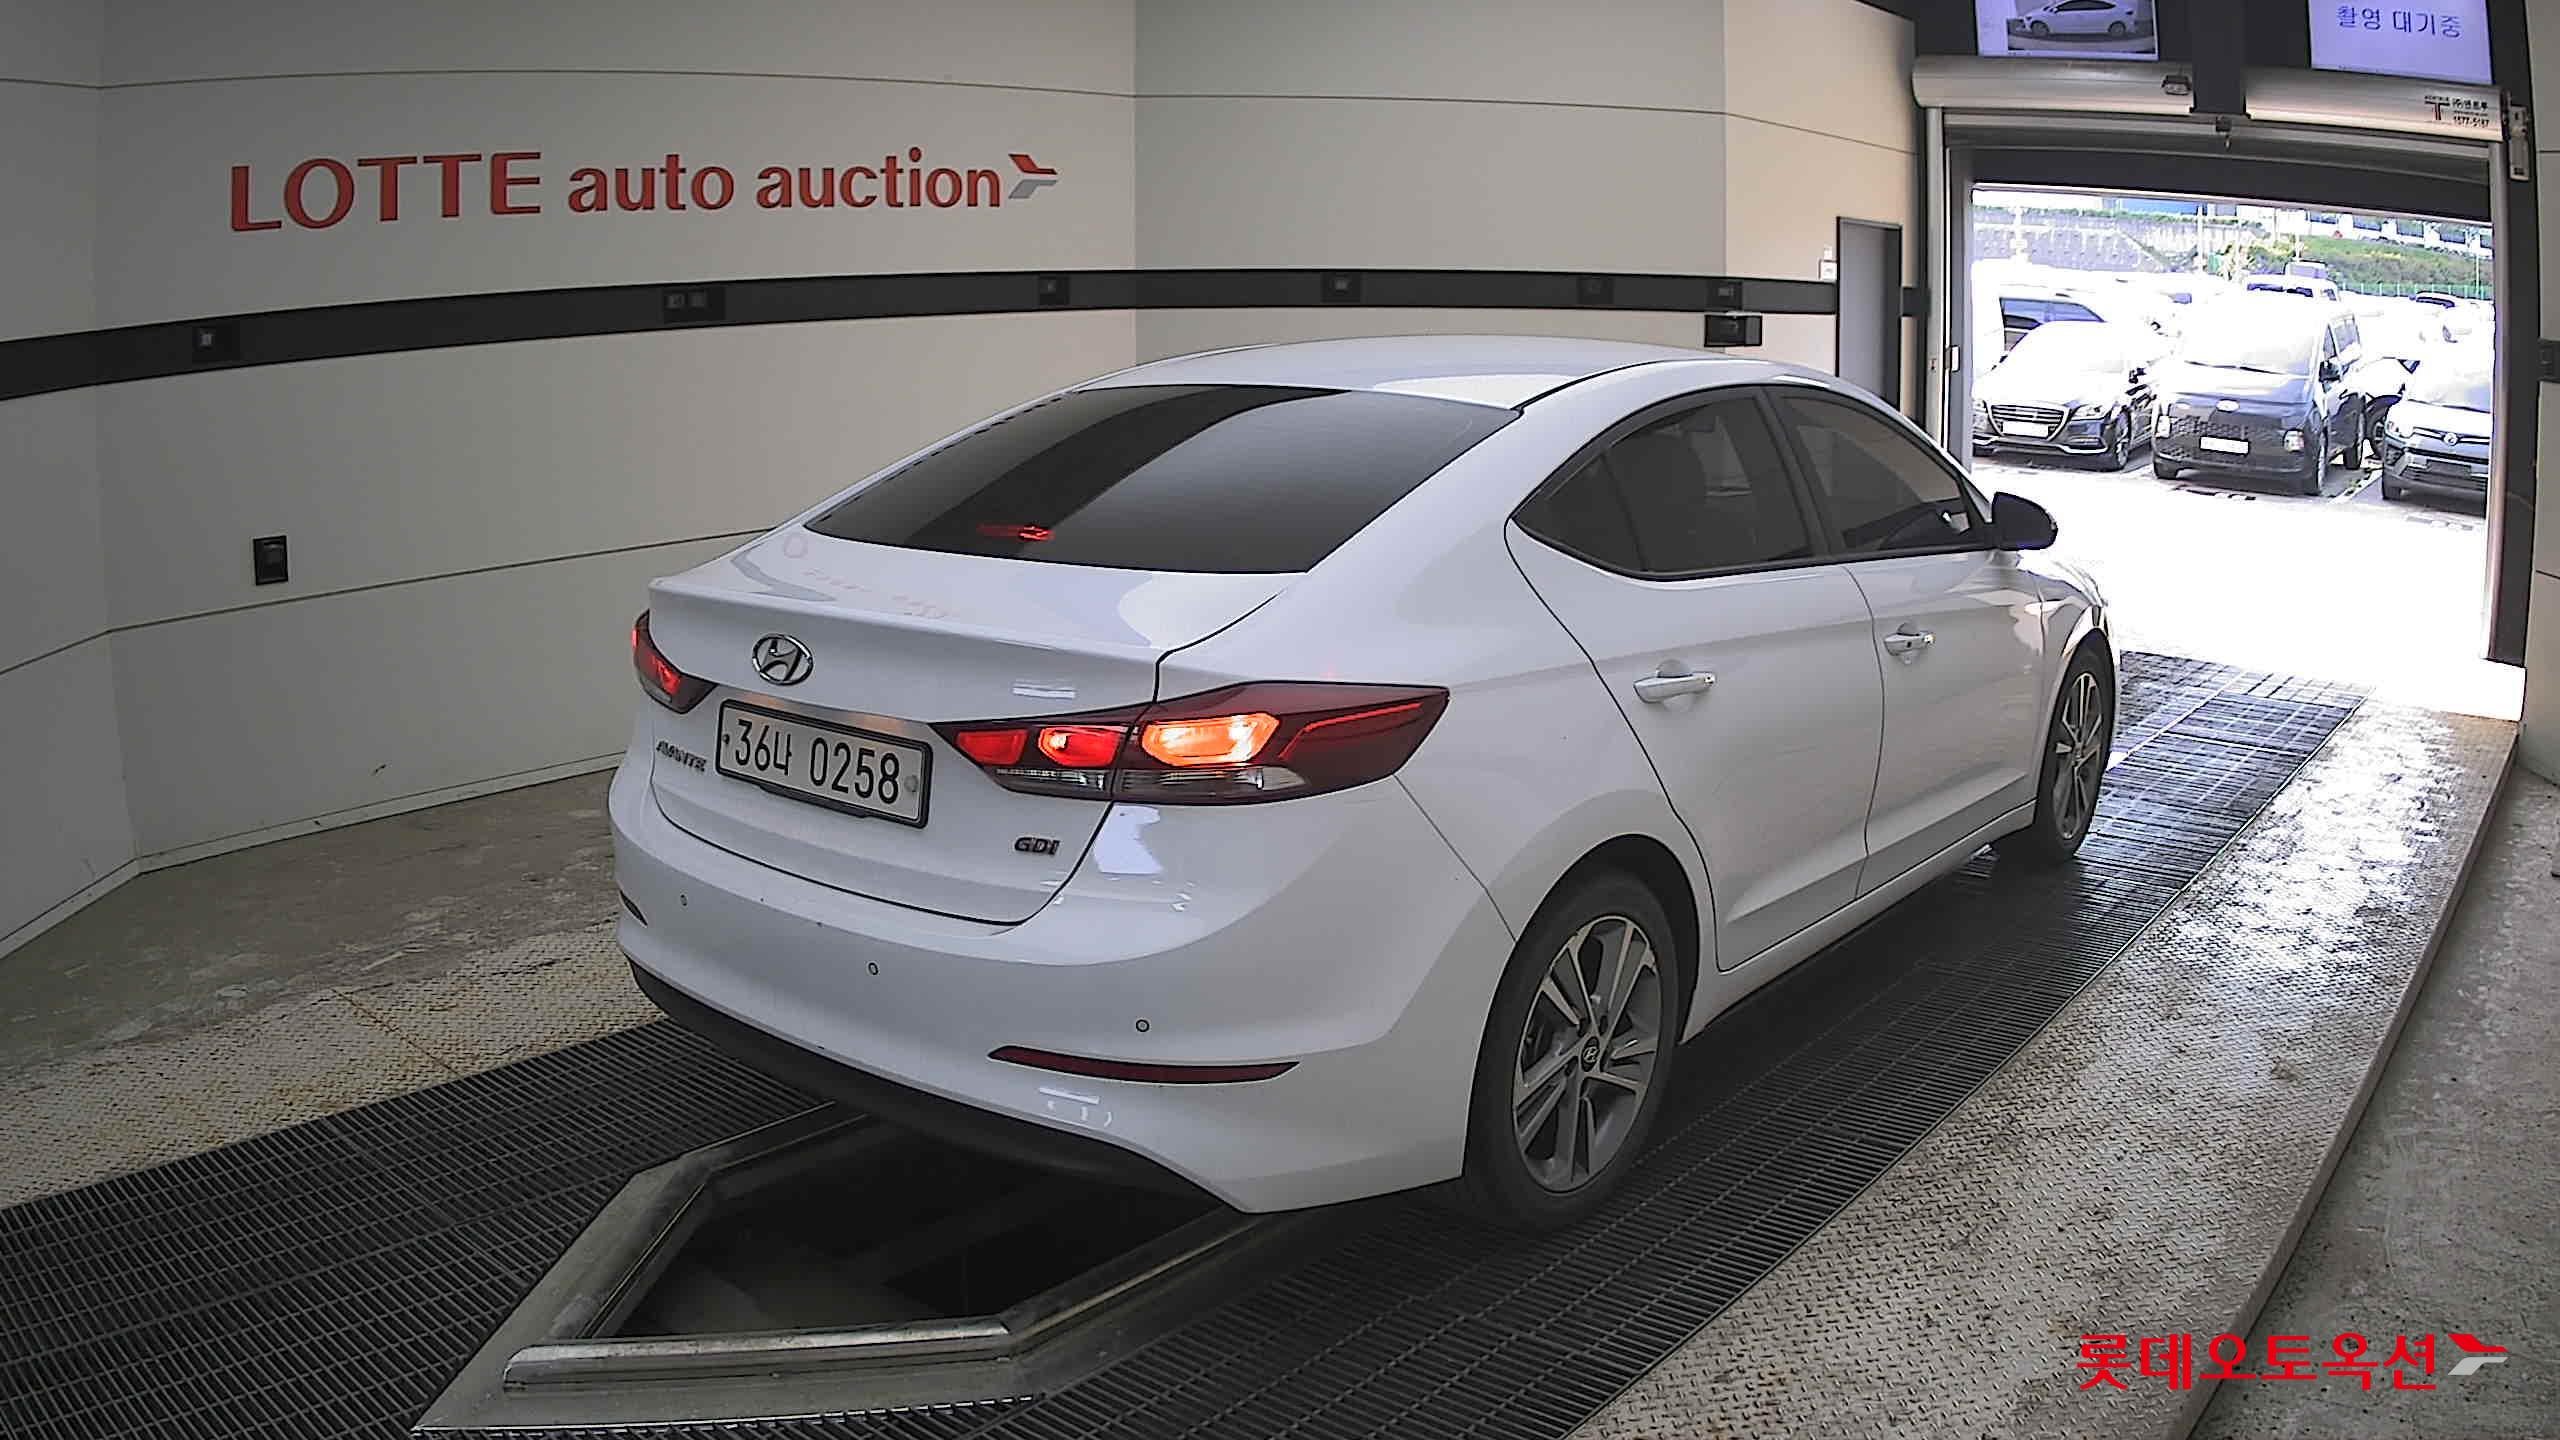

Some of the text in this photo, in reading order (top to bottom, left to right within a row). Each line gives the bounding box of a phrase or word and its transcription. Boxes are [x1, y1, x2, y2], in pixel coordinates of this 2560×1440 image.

[2337, 5, 2462, 38] 촬영 대기중
[231, 147, 1001, 231] LOTTE auto auction
[735, 718, 900, 805] 36나 0258
[1014, 836, 1060, 856] GDI
